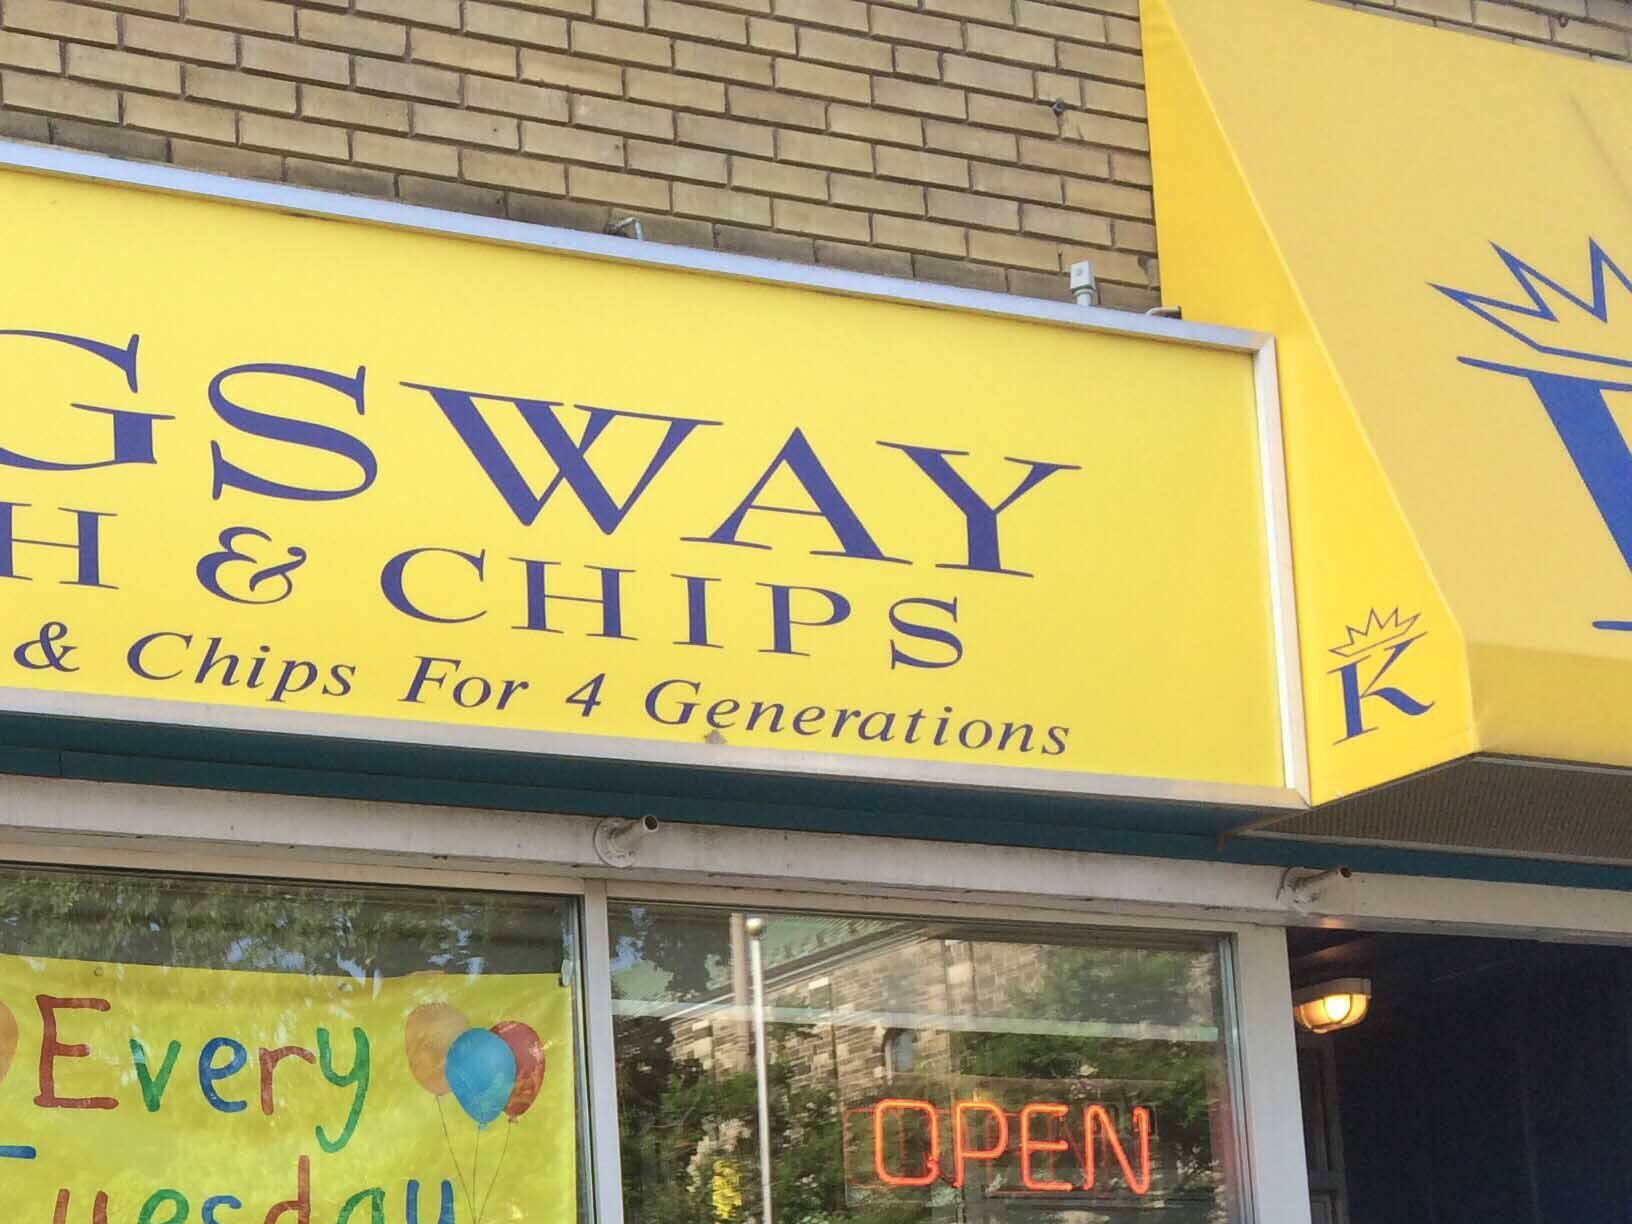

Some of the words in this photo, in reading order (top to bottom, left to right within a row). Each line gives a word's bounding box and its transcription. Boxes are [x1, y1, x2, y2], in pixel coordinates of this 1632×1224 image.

[196, 526, 307, 604] &
[380, 546, 964, 669] CHIPS
[13, 620, 80, 672] &
[128, 632, 357, 701] Chips
[399, 655, 529, 712] For
[566, 673, 603, 717] 4
[645, 678, 1071, 756] Generations
[1327, 631, 1435, 746] K
[34, 994, 370, 1153] Every
[873, 1099, 1150, 1195] OPEN
